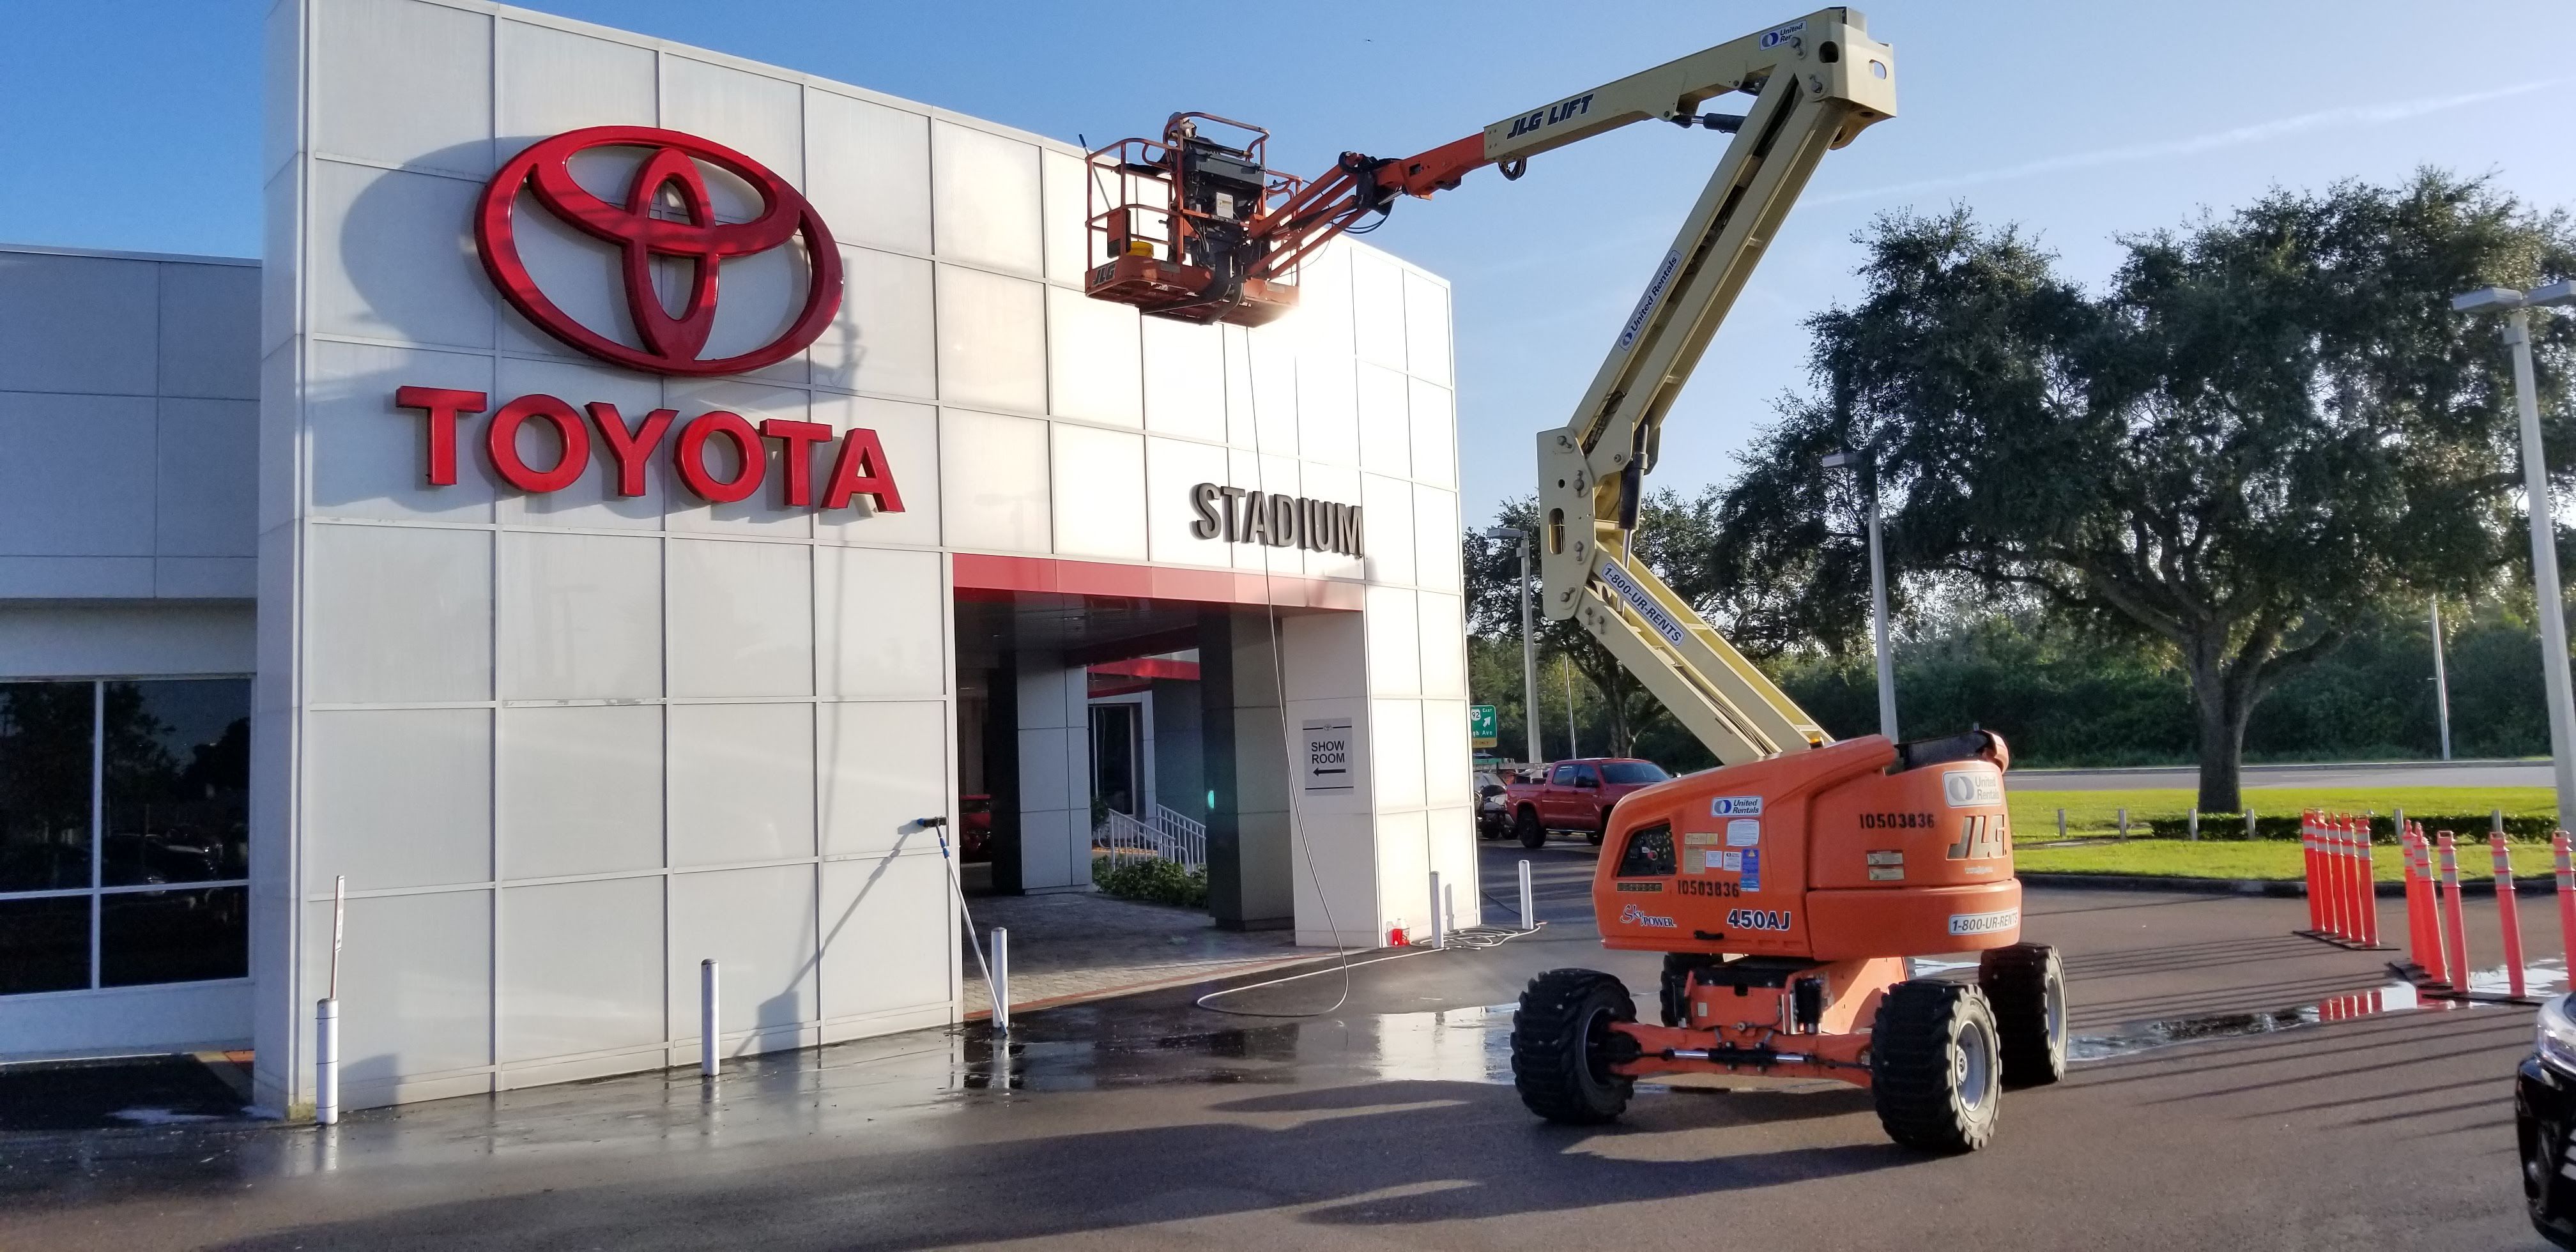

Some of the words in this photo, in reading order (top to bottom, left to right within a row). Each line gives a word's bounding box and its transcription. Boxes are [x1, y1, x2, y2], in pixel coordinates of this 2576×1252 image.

[1780, 22, 1803, 36] United
[1506, 111, 1544, 140] JLG
[1547, 93, 1595, 126] LIFT
[1092, 262, 1117, 287] JLG
[1630, 295, 1654, 332] United
[1651, 257, 1678, 297] Rentals
[395, 385, 905, 514] TOYOTA
[1195, 482, 1364, 556] STADIUM
[1604, 567, 1682, 642] 1-800-UR-RENTS
[1311, 740, 1345, 752] SHOW
[1312, 752, 1345, 764] ROOM
[1975, 776, 1996, 787] United
[1977, 789, 2000, 800] Rentals
[1859, 813, 1935, 829] 10503836
[1946, 814, 2005, 860] JLG
[1678, 879, 1740, 897] 10503836
[1727, 908, 1791, 931] 450AJ
[1952, 912, 2018, 931] 1-800-UR-RENTS
